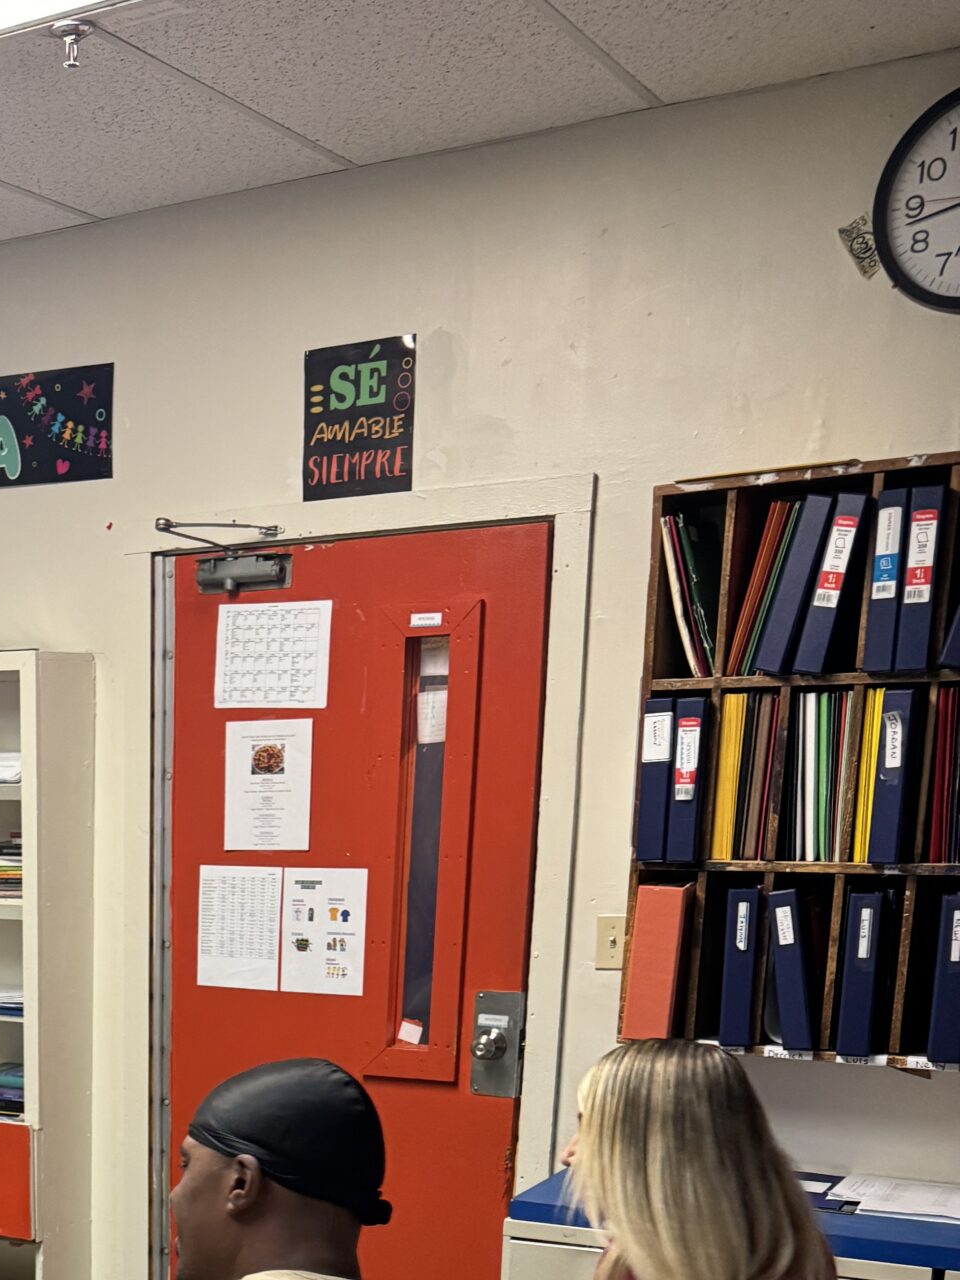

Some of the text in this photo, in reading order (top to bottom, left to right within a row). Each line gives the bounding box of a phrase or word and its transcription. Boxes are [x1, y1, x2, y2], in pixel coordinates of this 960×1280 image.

[917, 157, 947, 184] 10
[905, 195, 925, 218] 9
[911, 230, 929, 253] 8
[936, 252, 952, 276] 7
[329, 344, 387, 411] SÉ
[310, 413, 405, 446] AMABLE
[308, 446, 408, 486] SIEMPRE
